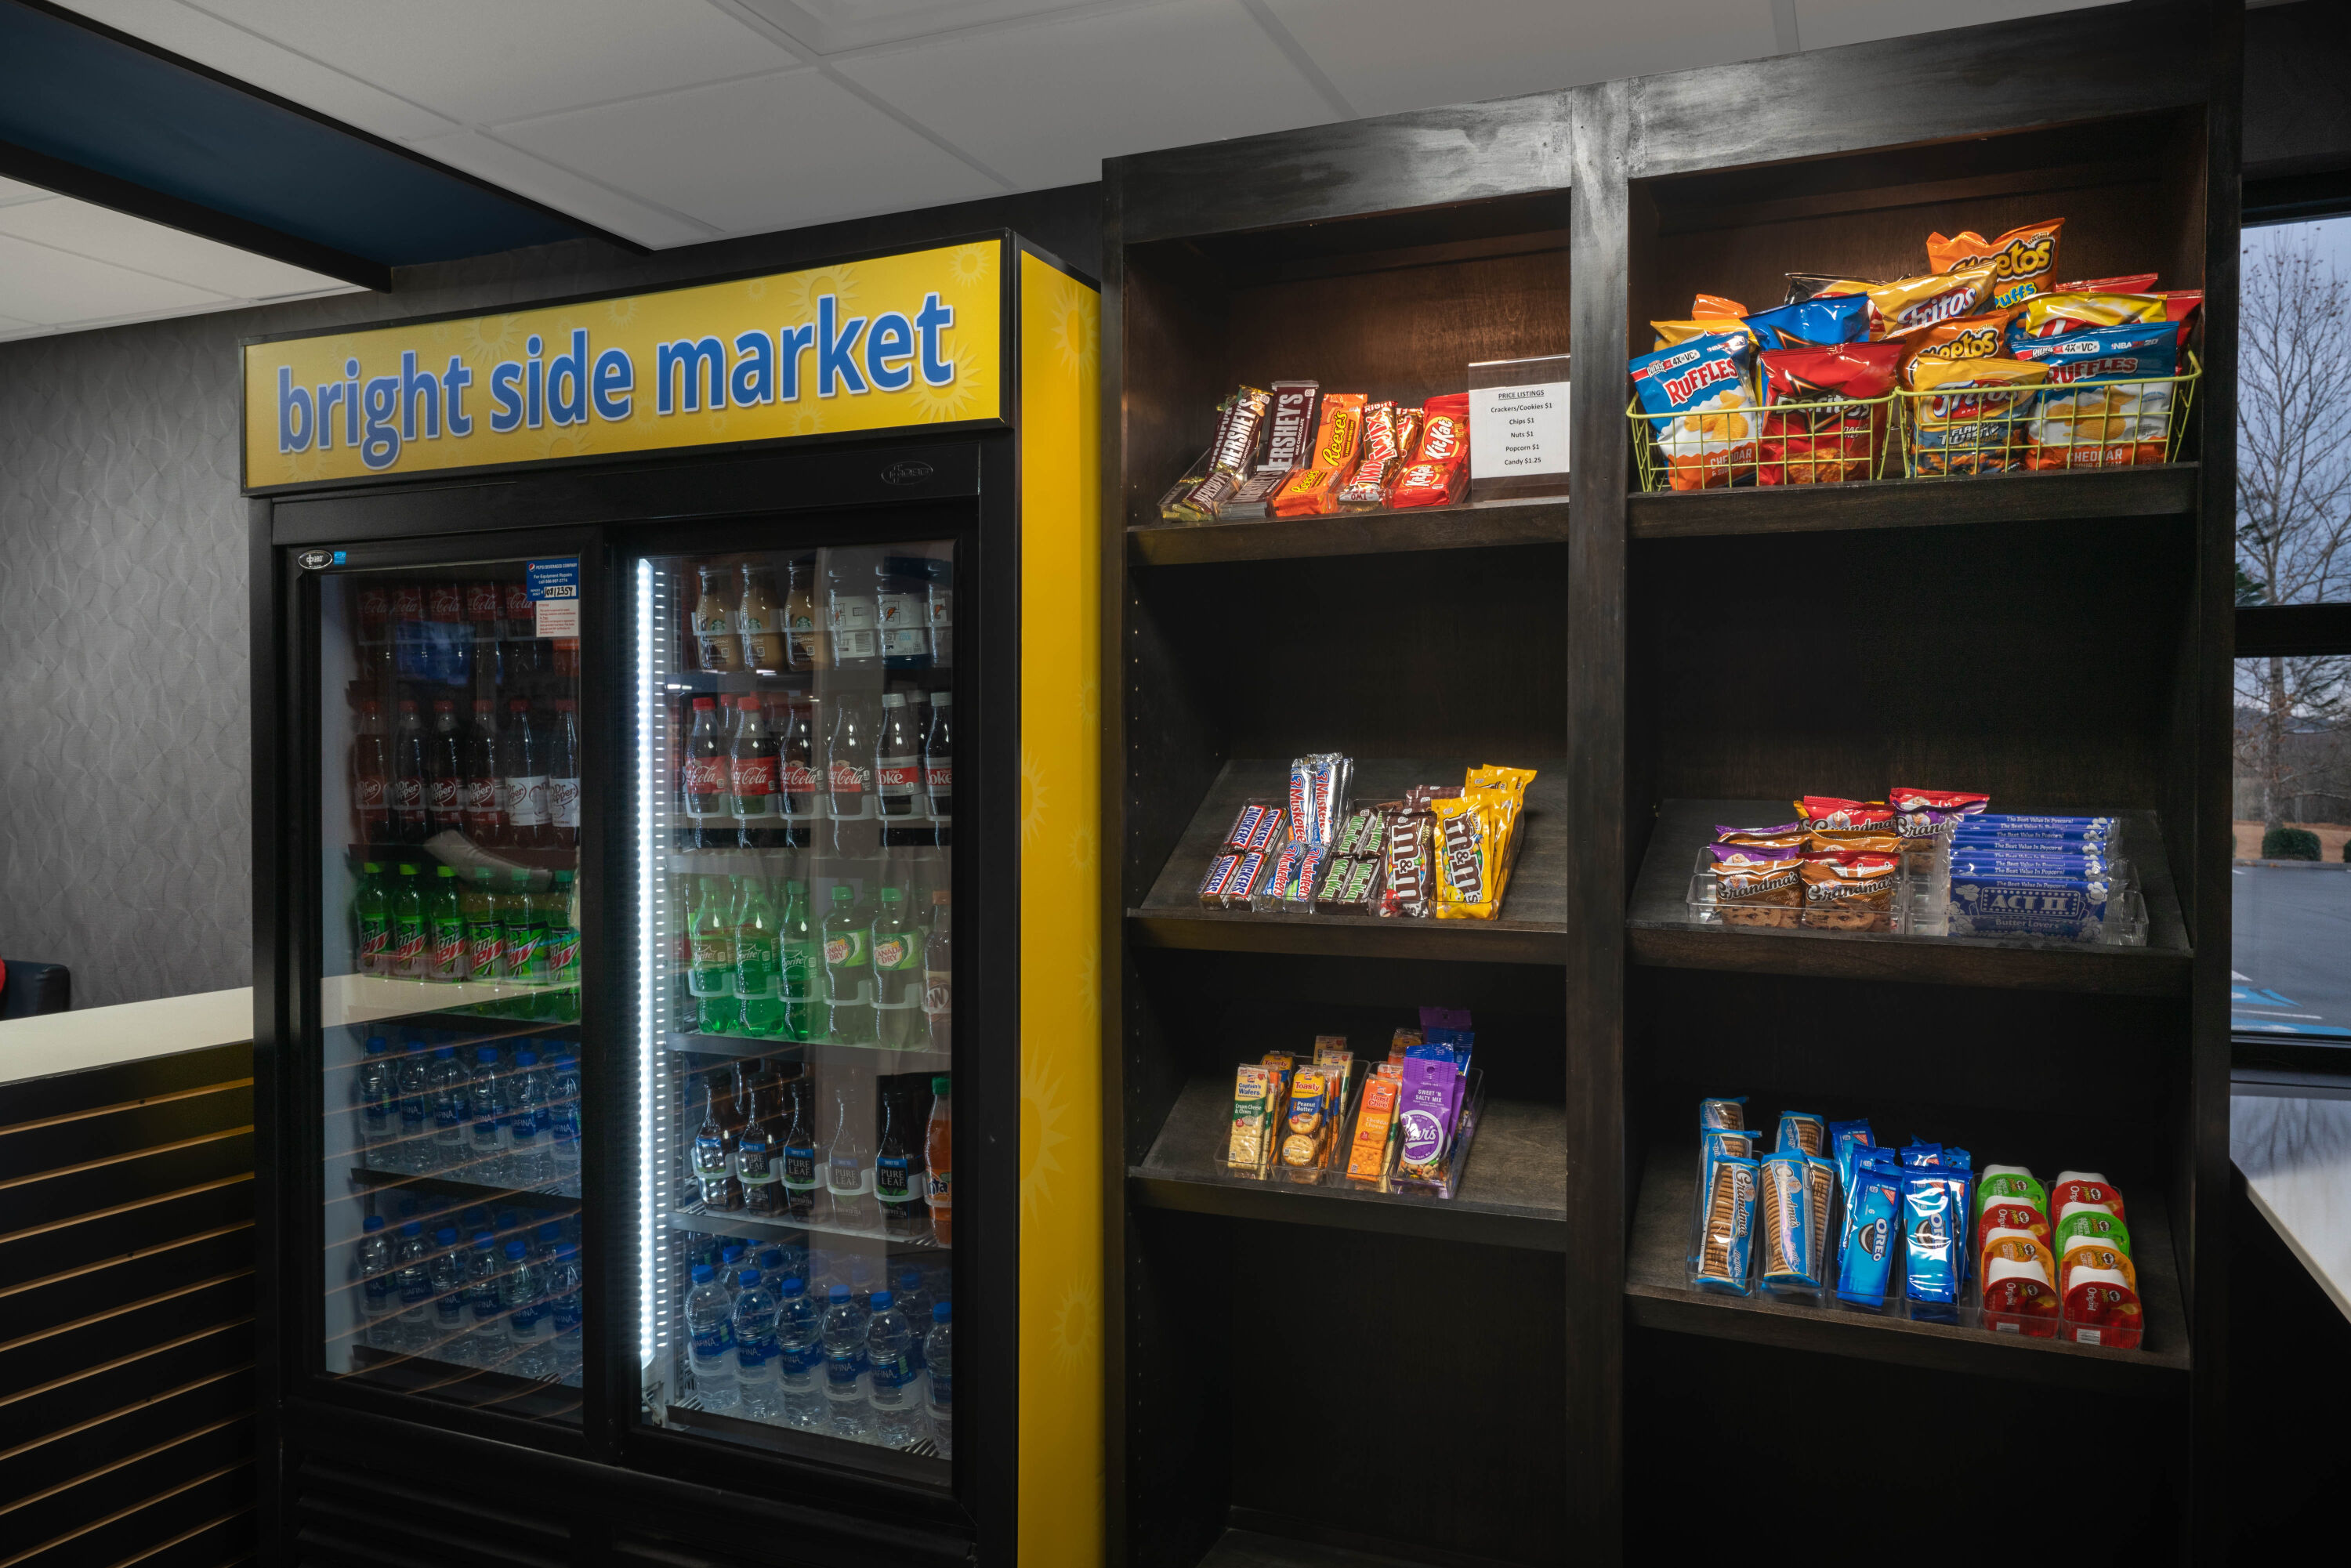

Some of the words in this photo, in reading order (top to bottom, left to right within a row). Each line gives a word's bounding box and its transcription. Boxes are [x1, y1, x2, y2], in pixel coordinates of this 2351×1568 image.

[1897, 287, 1977, 328] Fritos
[278, 350, 472, 470] bright
[489, 327, 633, 433] side
[656, 292, 955, 414] market
[1663, 357, 1739, 407] RUFFLES
[2045, 357, 2139, 390] RUFFLES
[1491, 403, 1544, 413] Crackers/Cookies
[1517, 389, 1545, 398] LISTINGS
[1219, 398, 1258, 468] HERSHEY'S
[1322, 411, 1348, 466] Reese's
[2067, 448, 2123, 462] CHEDAR
[1233, 807, 1262, 844] SNICKERS
[1253, 810, 1279, 846] SNICKERS
[1290, 788, 1308, 843] Musketee
[1205, 856, 1234, 892] SNICKERS
[1231, 853, 1260, 893] SNICKERS
[1273, 851, 1295, 899] Musketeers
[1297, 853, 1319, 902] Musketeers
[1716, 871, 1799, 900] Grandma's
[1806, 876, 1893, 902] Grandma's
[1991, 894, 2037, 910] ACT
[2041, 896, 2069, 911] II
[1995, 918, 2026, 927] Butter
[829, 952, 844, 961] DRY
[882, 954, 898, 964] DRY
[1295, 1082, 1320, 1092] Toasty
[1370, 1092, 1390, 1103] Toast
[788, 1158, 810, 1168] PURE
[835, 1168, 856, 1178] PURE
[882, 1168, 904, 1178] PURE
[1735, 1169, 1753, 1237] Grandma's
[2070, 1186, 2080, 1202] Orig
[1872, 1217, 1889, 1262] OREO
[1929, 1212, 1945, 1250] ORE
